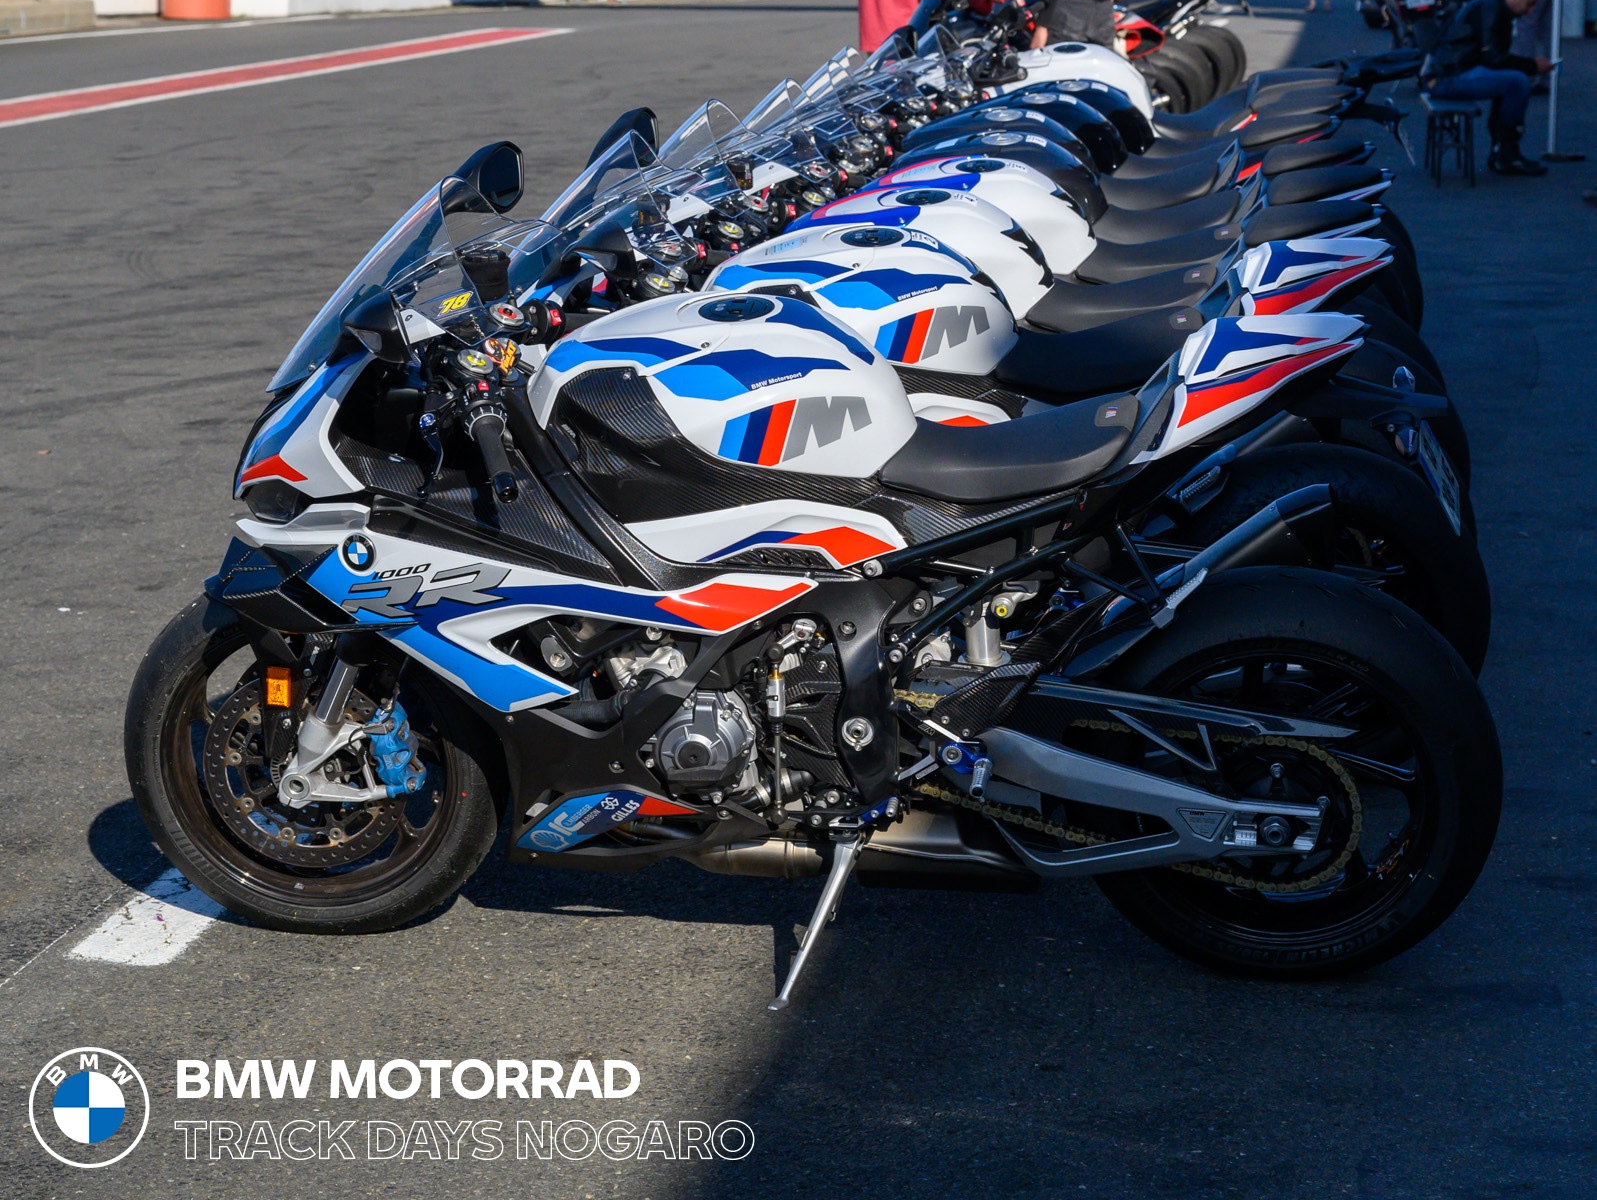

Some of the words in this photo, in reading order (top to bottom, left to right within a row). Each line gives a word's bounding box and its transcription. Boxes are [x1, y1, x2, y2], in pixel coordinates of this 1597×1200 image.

[440, 291, 473, 314] 78
[897, 292, 911, 302] BMW
[911, 285, 938, 298] Motorsport
[751, 379, 768, 390] BMW
[768, 371, 803, 386] Motorsport
[372, 562, 431, 580] 1000
[340, 563, 512, 618] RR
[611, 799, 641, 823] GILLES
